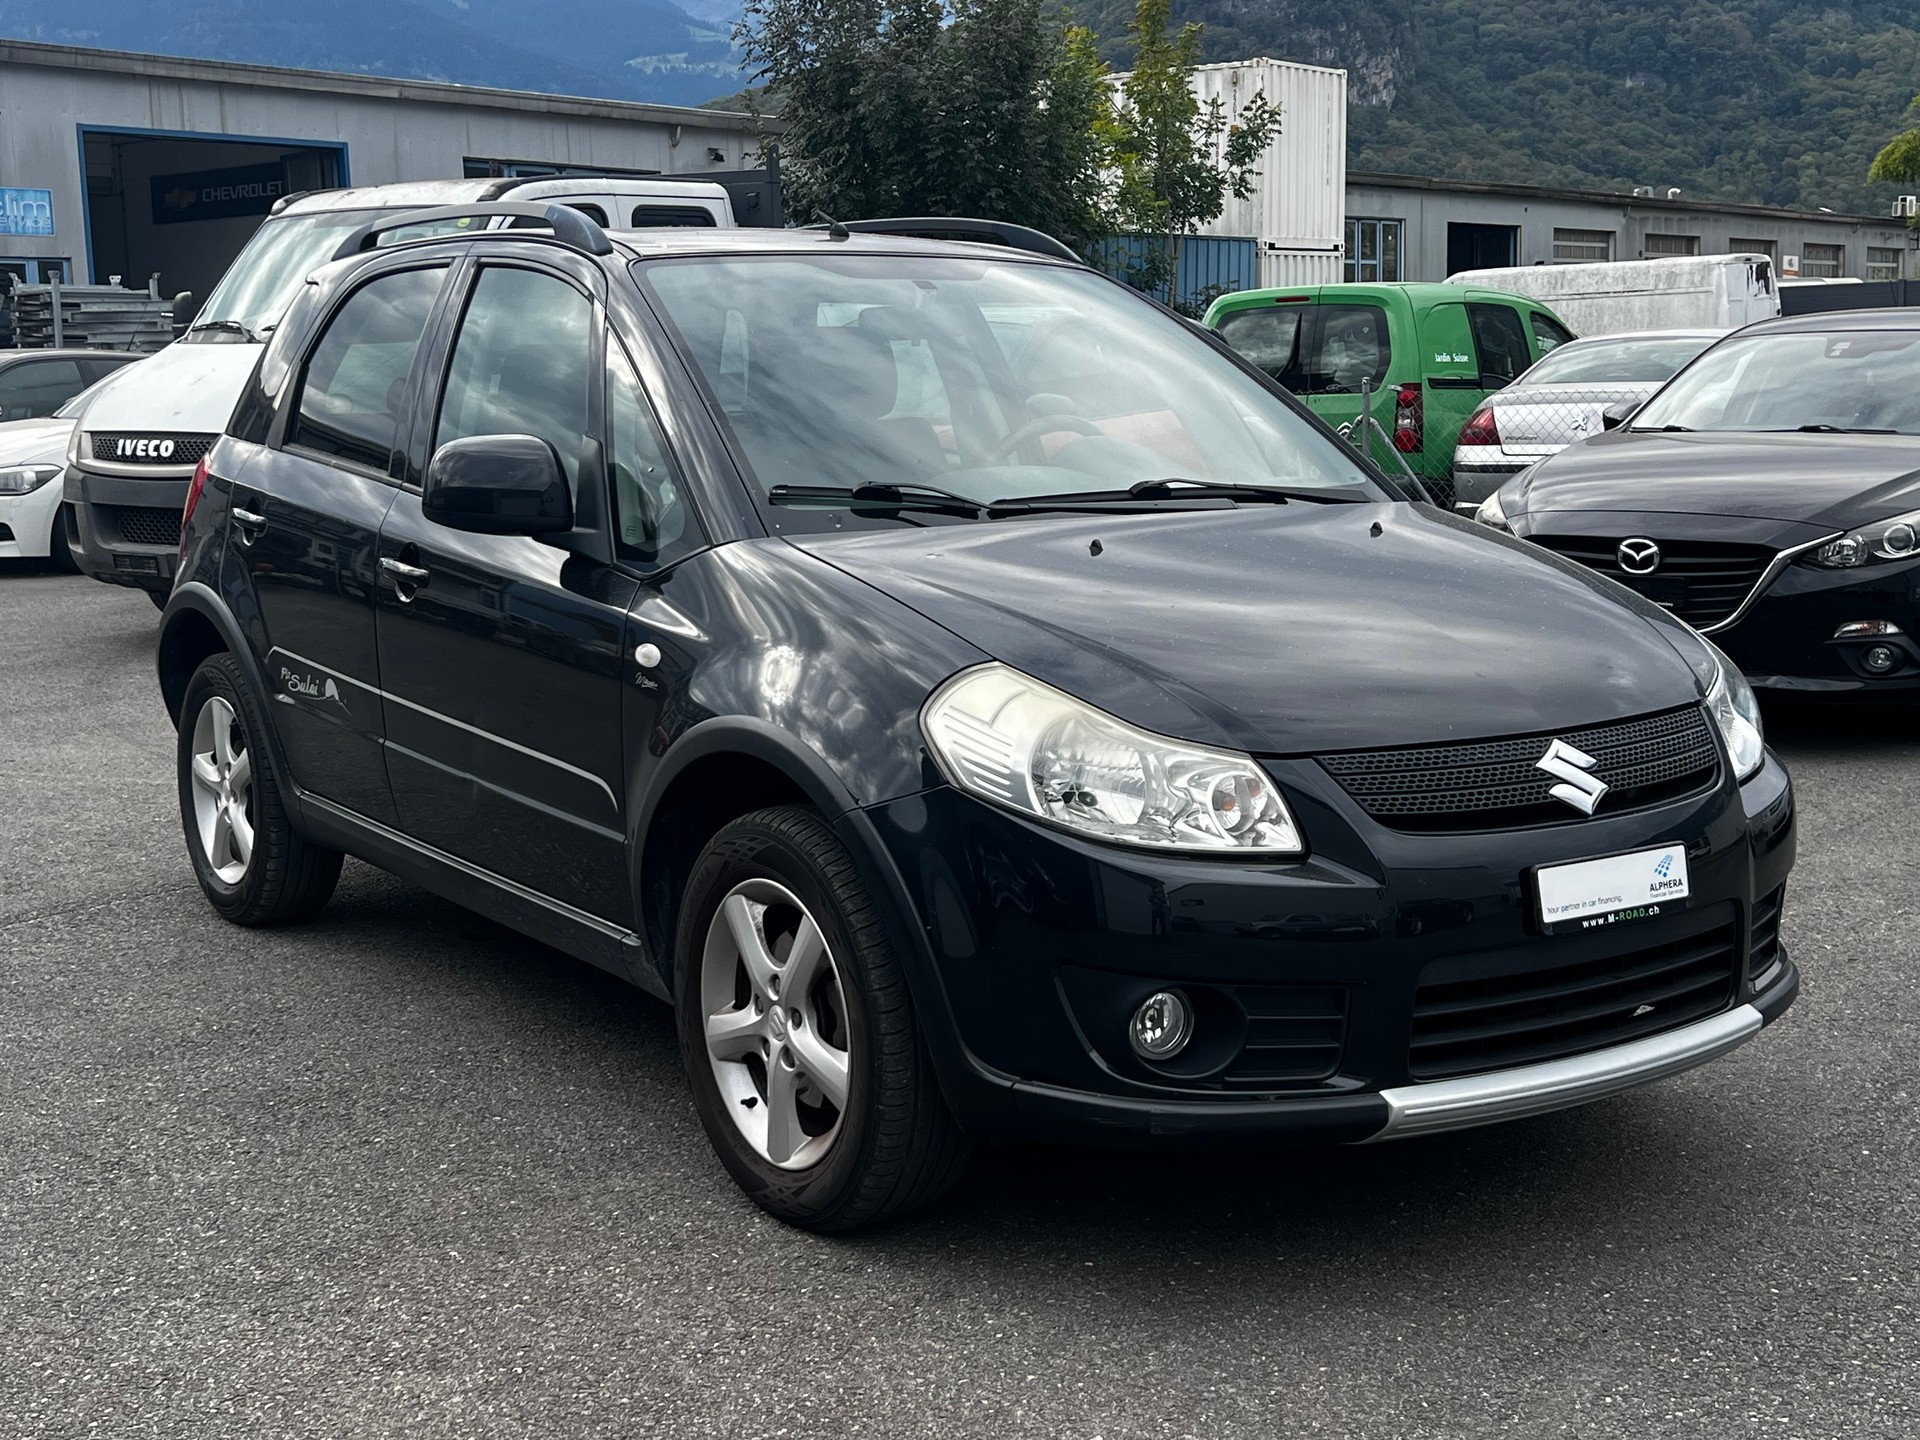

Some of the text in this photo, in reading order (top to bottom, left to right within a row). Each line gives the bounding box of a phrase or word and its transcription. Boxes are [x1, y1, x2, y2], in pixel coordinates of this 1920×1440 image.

[202, 181, 283, 202] CHEVROLET
[116, 438, 175, 457] IVECO
[1650, 878, 1683, 892] ALPHERA
[1546, 906, 1560, 914] Your
[1561, 903, 1581, 913] partner
[1582, 905, 1660, 928] www.M-ROAD.ch
